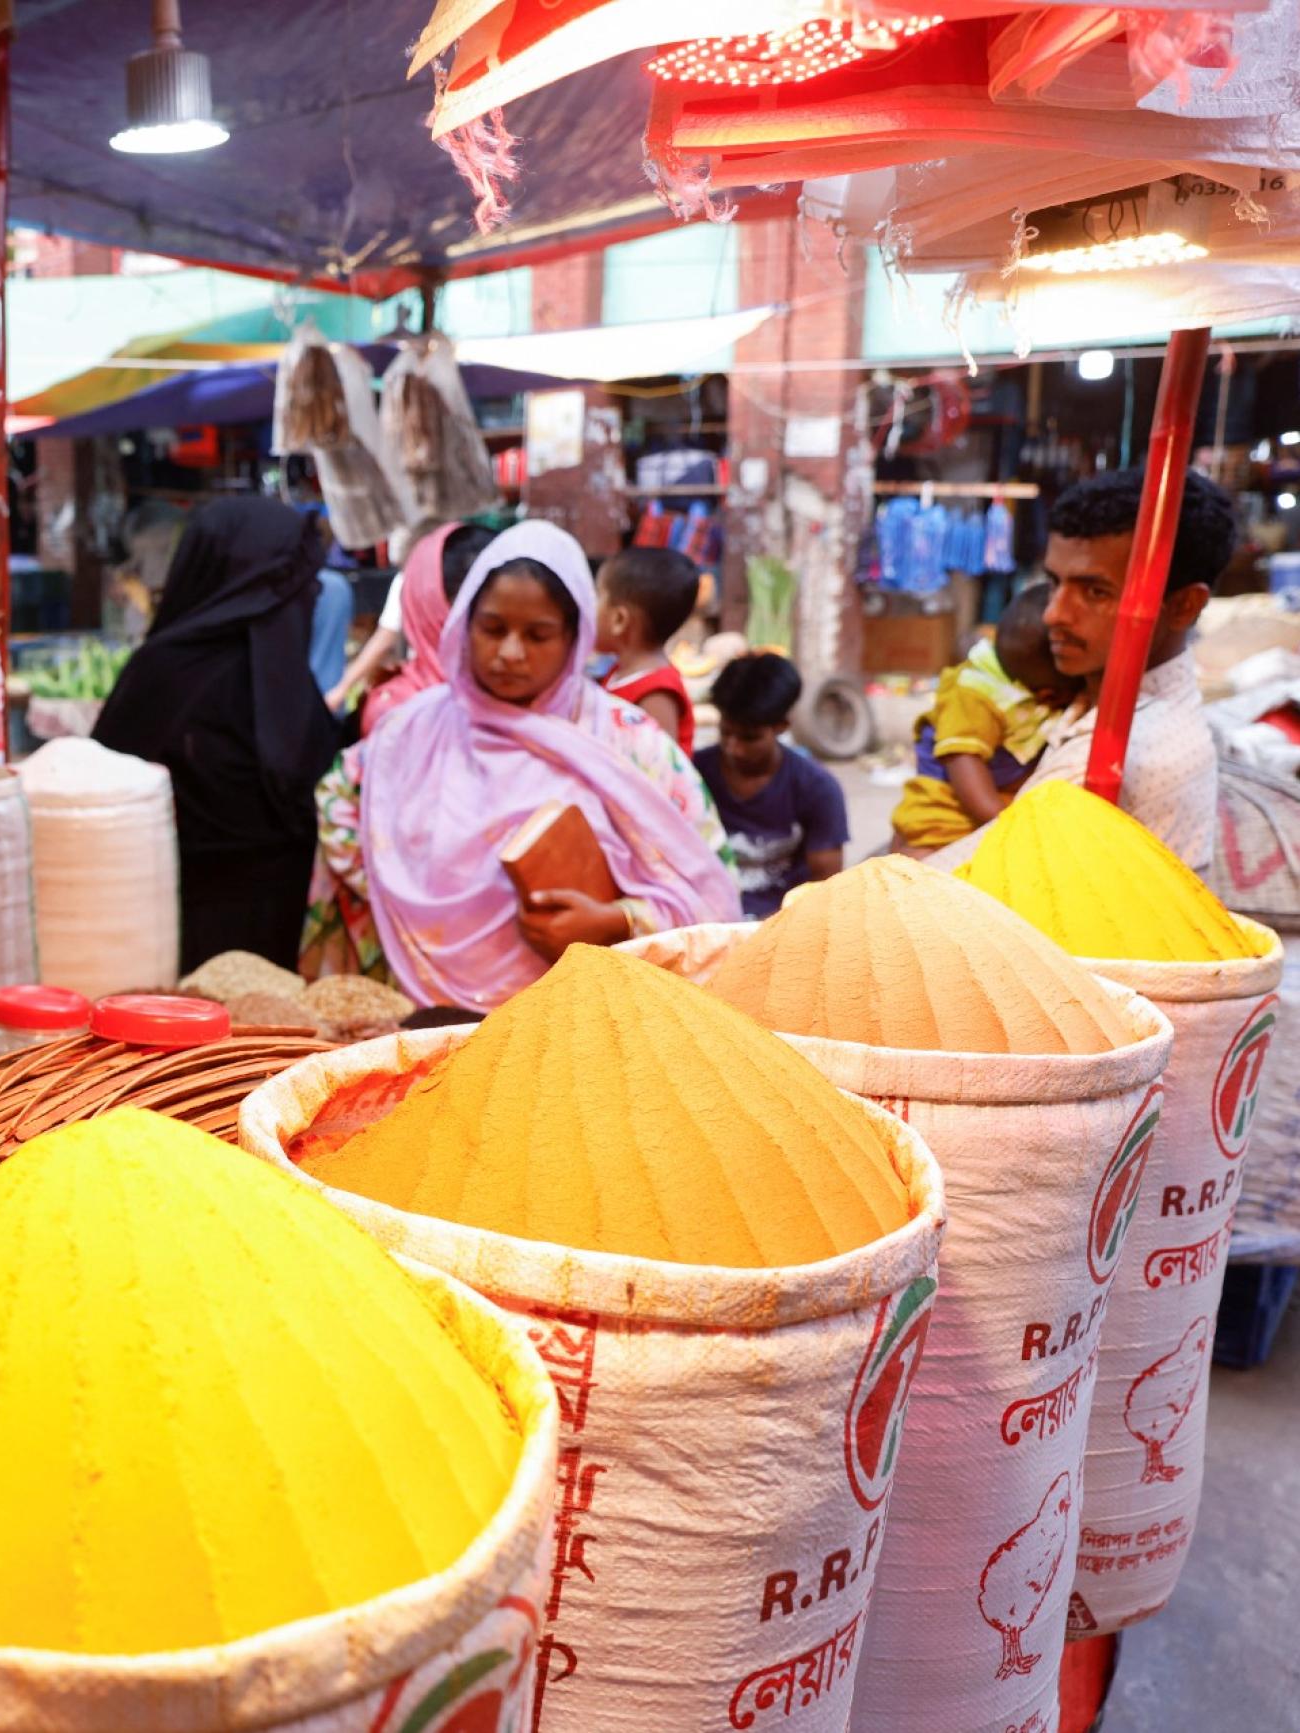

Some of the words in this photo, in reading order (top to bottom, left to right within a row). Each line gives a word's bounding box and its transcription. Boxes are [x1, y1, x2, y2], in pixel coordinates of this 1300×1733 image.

[1144, 1229, 1221, 1290] লেয়ার
[1001, 1364, 1084, 1446] লেয়ার
[729, 1610, 863, 1730] লেয়ার
